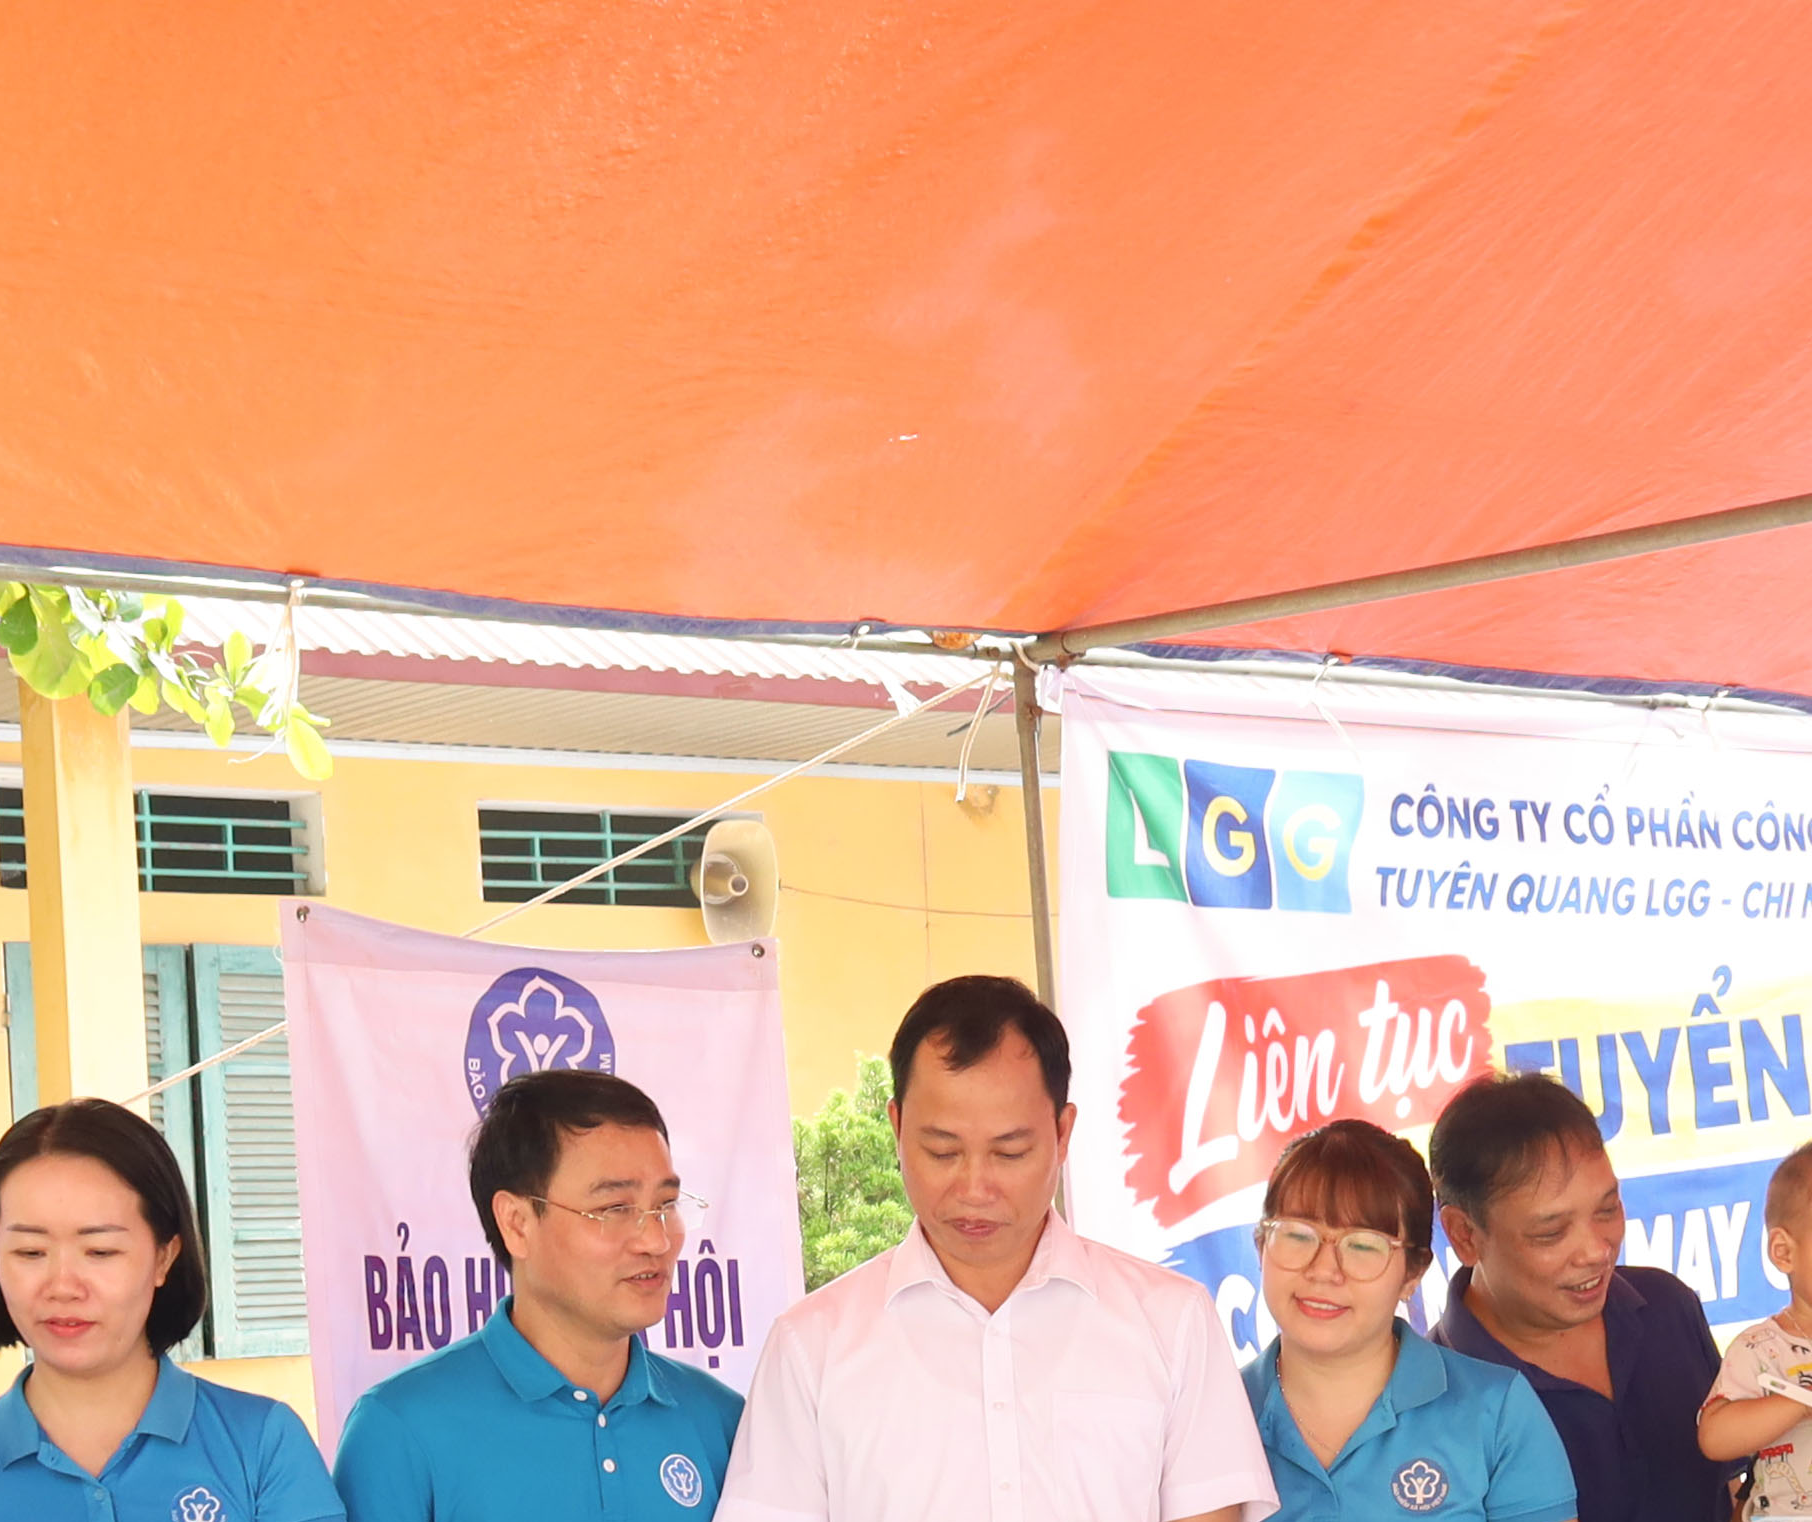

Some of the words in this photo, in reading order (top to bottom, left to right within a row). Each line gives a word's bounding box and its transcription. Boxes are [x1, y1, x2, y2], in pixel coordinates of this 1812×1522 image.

[1390, 783, 1500, 842] CÔNG
[1509, 800, 1552, 843] TY
[1563, 784, 1615, 846] CỔ
[1626, 790, 1722, 849] PHẦN
[1375, 861, 1497, 911] TUYÊN
[1506, 872, 1636, 916] QUANG
[1645, 877, 1711, 917] LGG
[1742, 880, 1796, 920] CHI
[467, 1057, 487, 1100] BẢO
[1168, 1001, 1345, 1194] Liên
[1358, 980, 1474, 1120] tục
[364, 1221, 453, 1352] BẢO
[665, 1238, 745, 1370] HỘI
